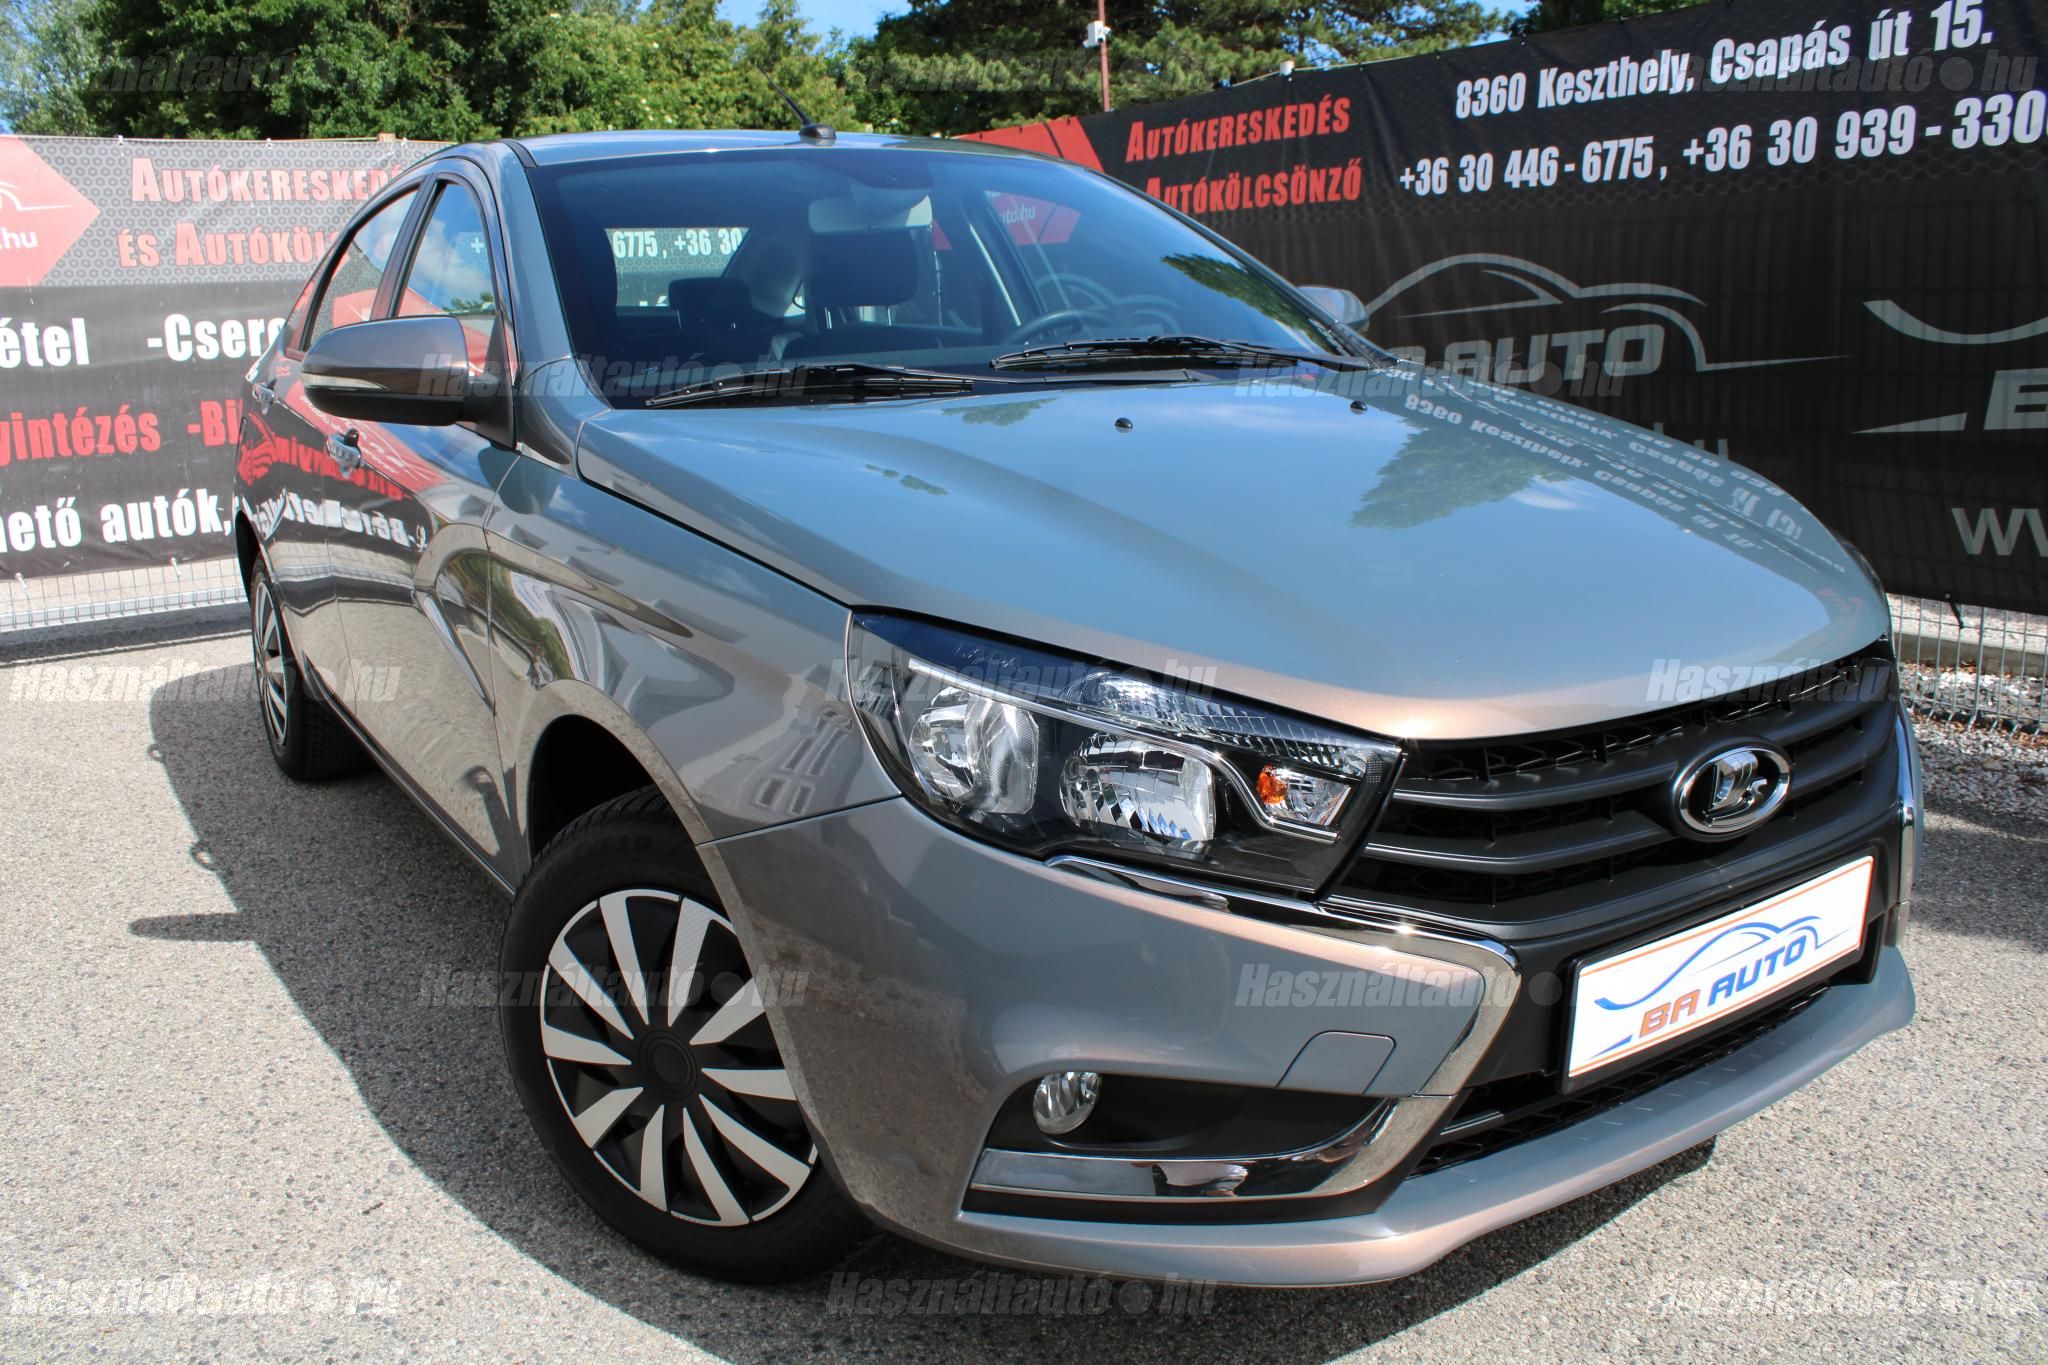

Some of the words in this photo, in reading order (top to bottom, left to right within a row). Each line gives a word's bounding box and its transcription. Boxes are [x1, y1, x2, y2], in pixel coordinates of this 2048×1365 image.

[1455, 73, 1527, 119] 8360
[1537, 49, 1695, 108] Keszthely,
[1710, 20, 1851, 84] Csapás
[1869, 8, 1912, 61] út
[1930, 0, 1993, 51] 15.
[1125, 94, 1350, 163] AUTÓKERESKEDÉS
[1399, 157, 1449, 196] +36
[1458, 152, 1494, 193] 30
[1683, 124, 1752, 172] +36
[1767, 116, 1818, 166] 30
[1835, 90, 2048, 159] 939-330
[132, 157, 402, 202] AUTÓKERESKED
[118, 228, 160, 267] ÉS
[674, 229, 712, 256] +36
[717, 227, 743, 255] 30
[1444, 324, 1665, 383] AUTO
[0, 497, 82, 553] ető
[101, 488, 232, 543] autók,
[1639, 989, 1700, 1038] BA
[1706, 935, 1807, 1006] AUTO
